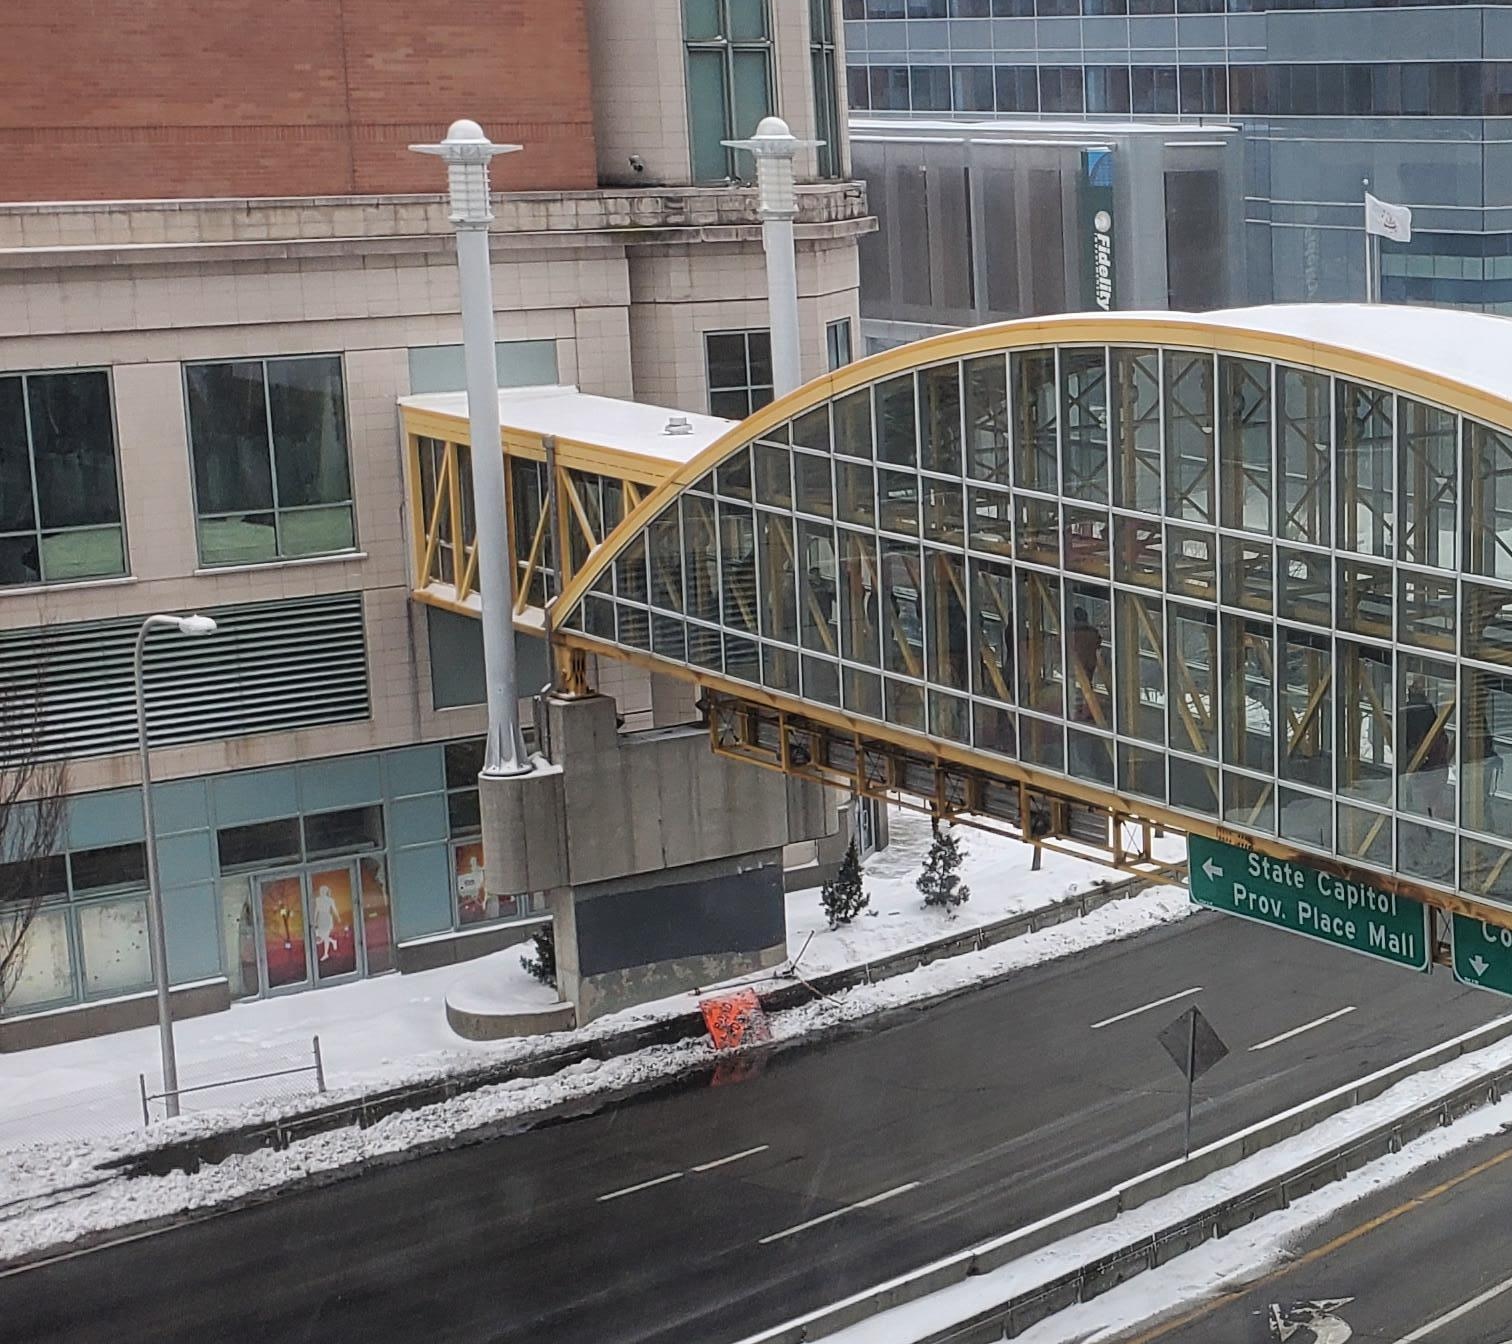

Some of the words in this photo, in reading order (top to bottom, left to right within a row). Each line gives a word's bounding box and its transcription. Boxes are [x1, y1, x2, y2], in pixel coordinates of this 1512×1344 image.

[1096, 233, 1111, 311] Fidelity
[1233, 882, 1286, 919] Prov.
[1298, 901, 1356, 940] Place
[1369, 922, 1414, 958] Mall
[1248, 852, 1304, 888] State
[1317, 871, 1396, 916] Capitol
